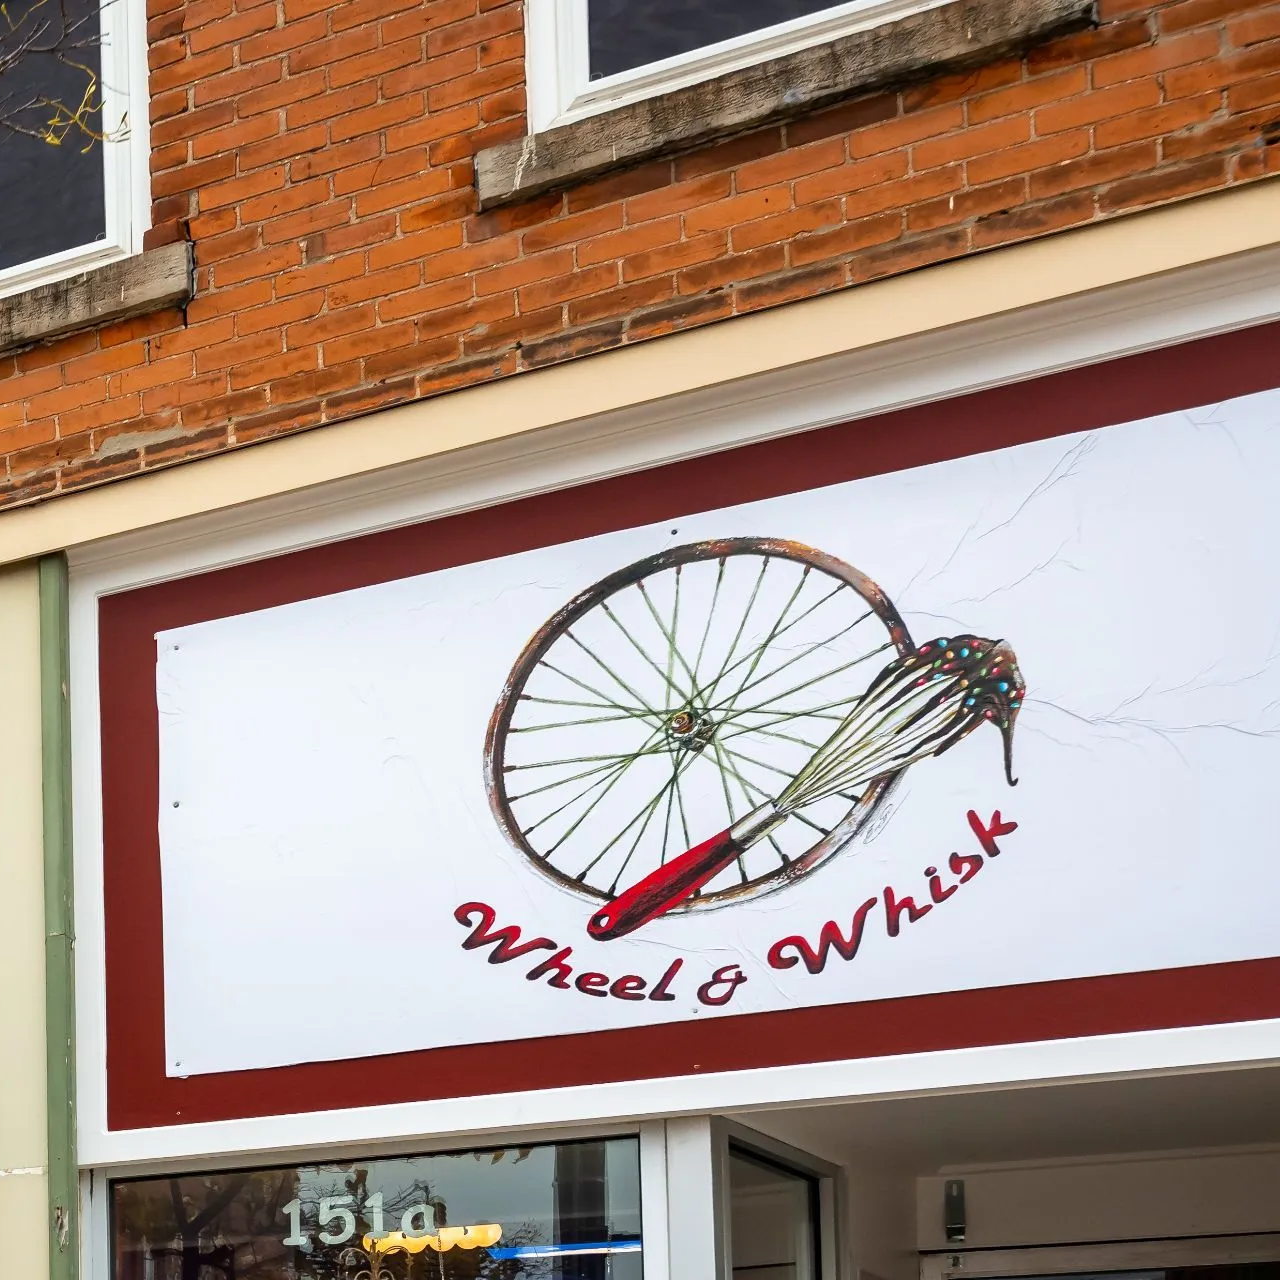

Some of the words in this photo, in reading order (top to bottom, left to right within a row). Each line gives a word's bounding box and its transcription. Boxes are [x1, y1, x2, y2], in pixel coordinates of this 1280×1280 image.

[453, 901, 684, 1002] Wheel
[696, 964, 747, 1007] &
[766, 809, 1020, 975] Whisk
[281, 1195, 439, 1247] 151a
